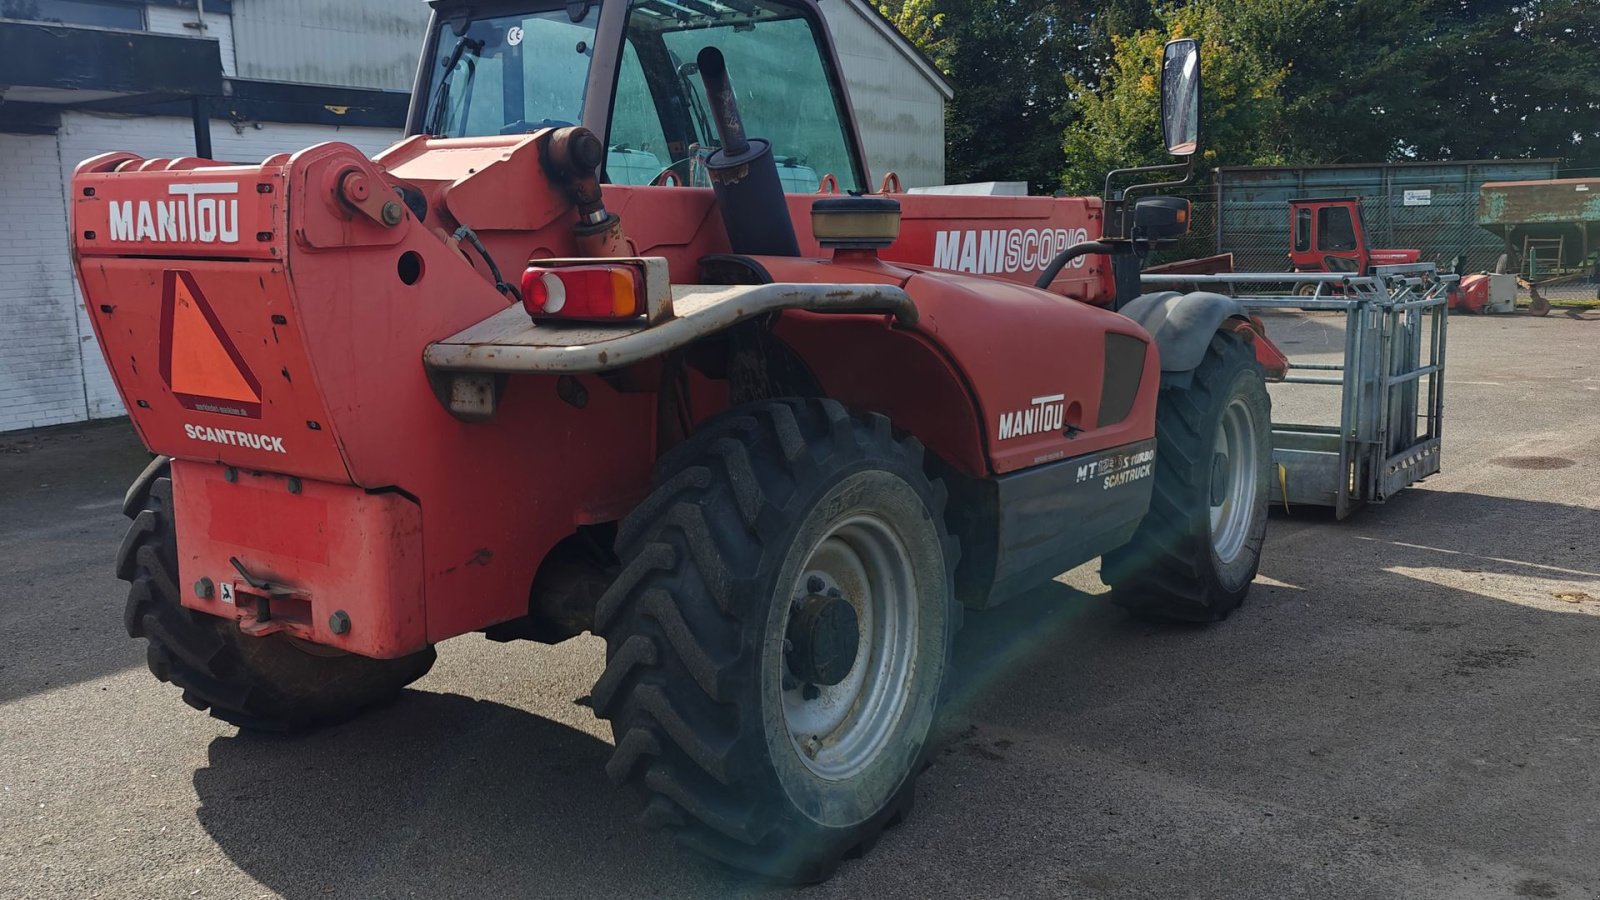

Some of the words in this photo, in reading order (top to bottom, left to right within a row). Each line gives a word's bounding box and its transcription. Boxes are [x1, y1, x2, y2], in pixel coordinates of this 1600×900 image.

[509, 28, 521, 41] CE
[109, 182, 239, 243] MANITOU
[999, 393, 1065, 440] MANITOU
[184, 423, 287, 454] SCANTRUCK
[1131, 449, 1154, 466] TURBO
[1103, 463, 1152, 490] SCANTRUCK
